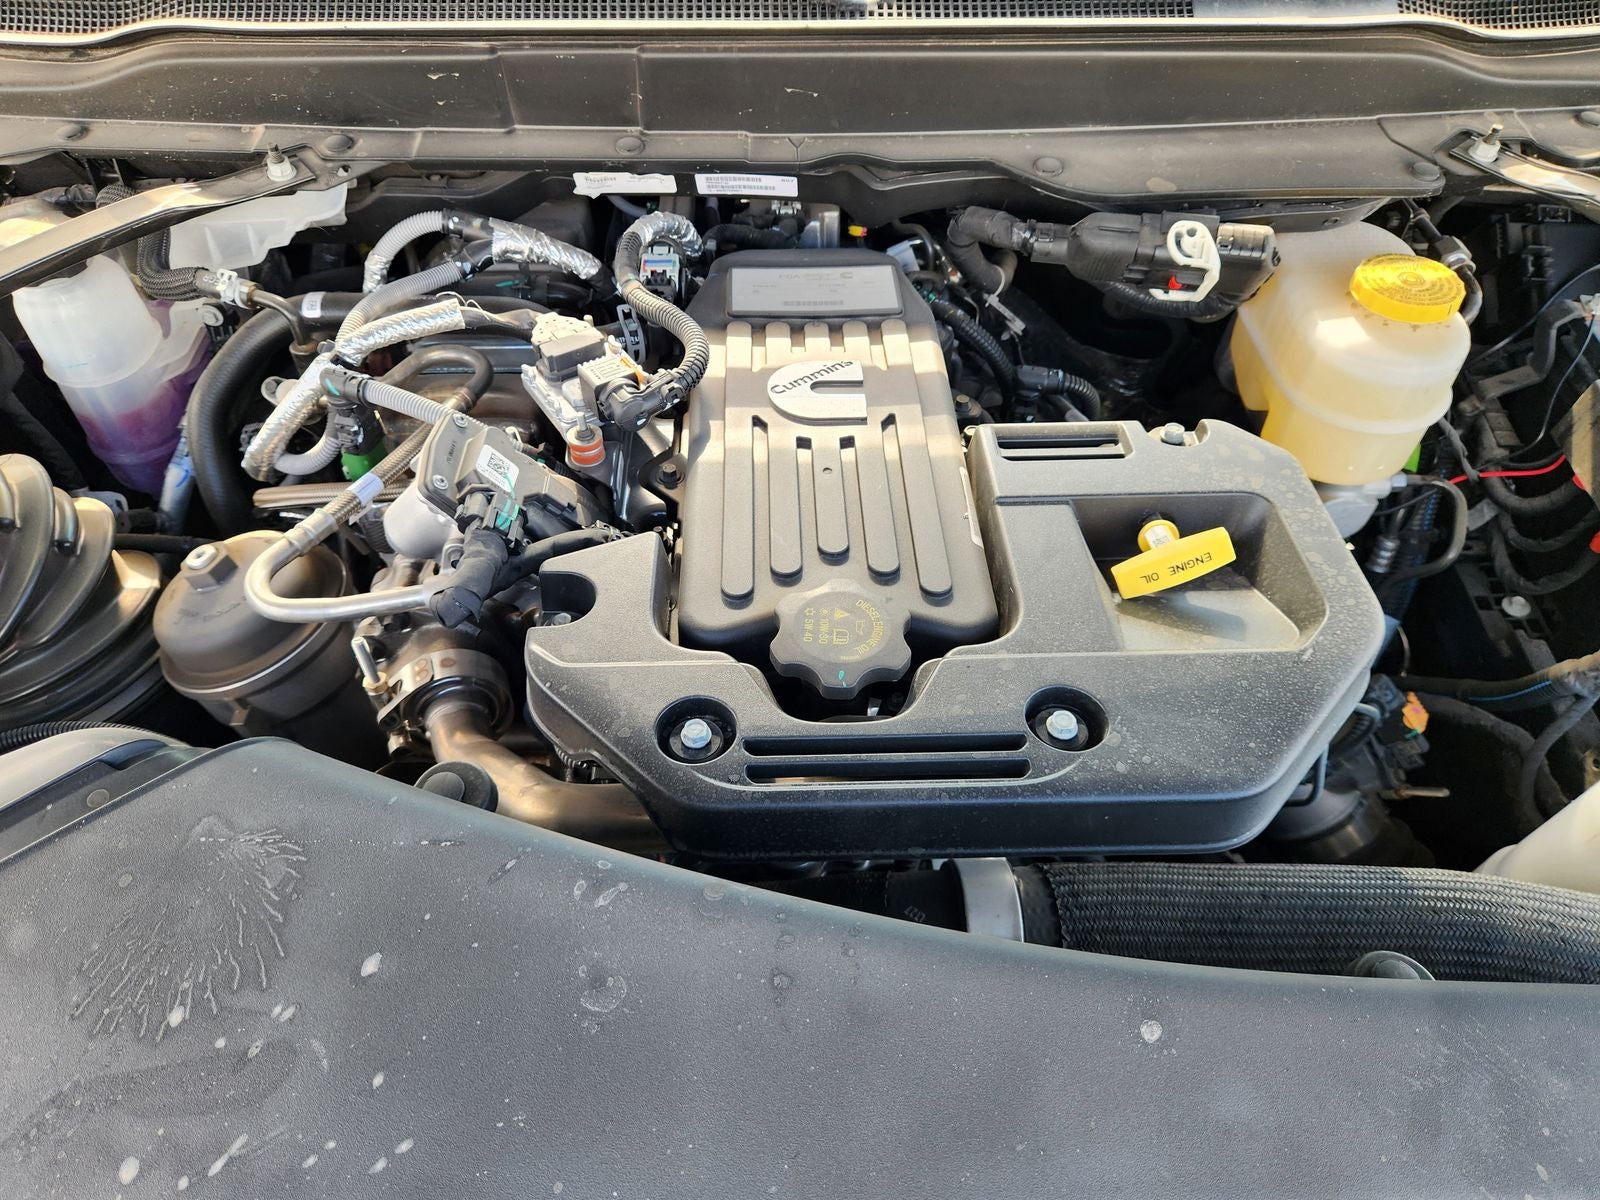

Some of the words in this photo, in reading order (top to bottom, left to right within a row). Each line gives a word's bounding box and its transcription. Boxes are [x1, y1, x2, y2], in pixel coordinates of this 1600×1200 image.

[770, 360, 853, 394] Cummins
[1167, 552, 1213, 576] ENGINE
[1139, 572, 1160, 584] OIL
[855, 599, 881, 621] DIESEL
[803, 619, 814, 642] 5W-40
[866, 621, 884, 648] ENGINE
